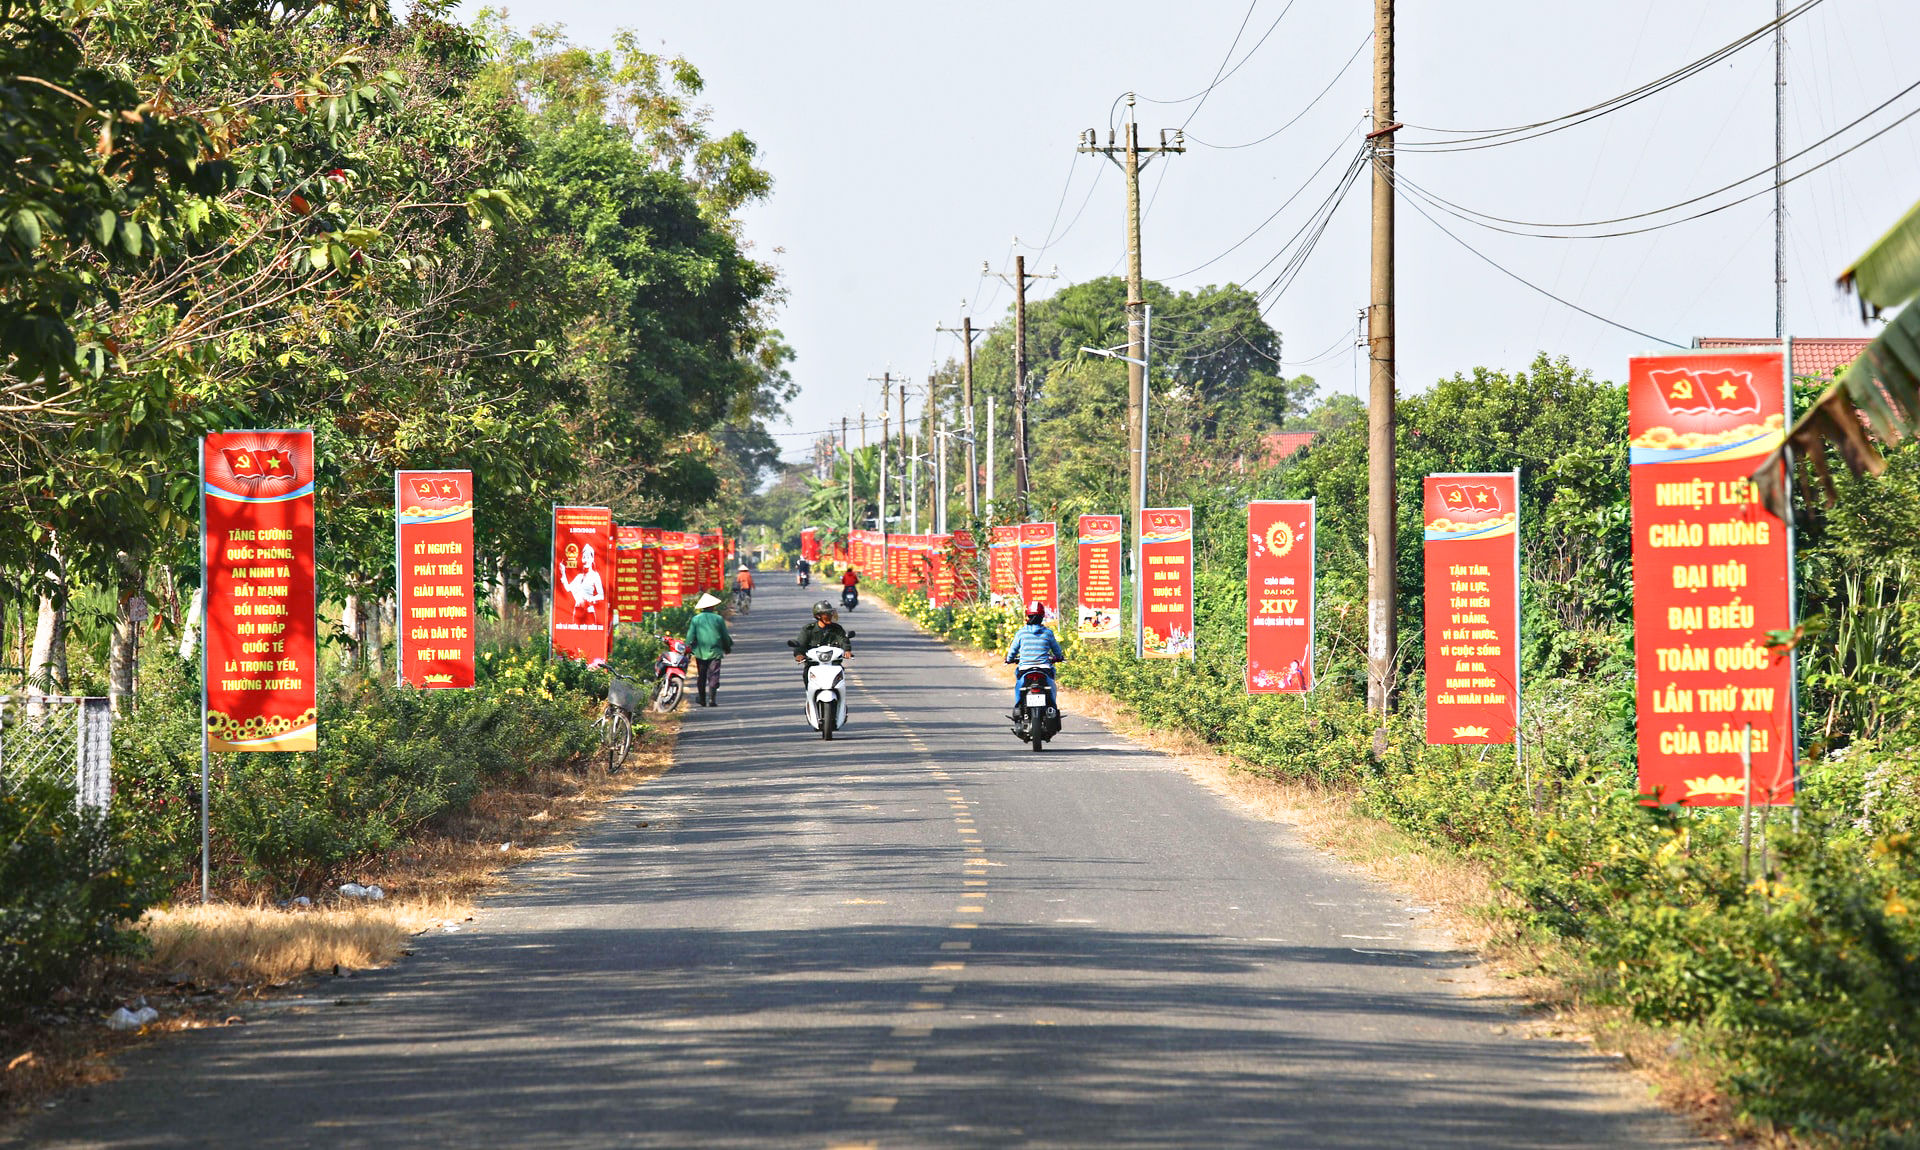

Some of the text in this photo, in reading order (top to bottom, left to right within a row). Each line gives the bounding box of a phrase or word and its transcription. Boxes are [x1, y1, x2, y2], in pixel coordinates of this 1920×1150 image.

[1656, 478, 1714, 510] NHIỆT
[229, 528, 292, 540] TĂNG CƯỜNG
[1649, 518, 1769, 548] CHÀO MỪNG
[227, 546, 294, 560] QUỐC PHÒNG,
[415, 540, 462, 554] KỶ NGUYÊN
[232, 565, 290, 578] AN NINH VÀ
[414, 560, 463, 575] PHÁT TRIỂN
[1450, 564, 1490, 577] TẬN TÂM,
[1672, 560, 1746, 592] ĐẠI HỘI
[234, 584, 288, 598] ĐẨY MẠNH
[414, 584, 464, 598] GIÀU MẠNH,
[1451, 580, 1489, 593] TẬN LỰC,
[234, 602, 288, 617] ĐỐI NGOẠI,
[1260, 599, 1298, 613] XIV
[1450, 596, 1490, 609] TẬN HIẾN
[411, 606, 466, 620] THỊNH VƯỢNG
[1452, 612, 1489, 624] VÌ ĐẢNG,
[1668, 597, 1754, 634] ĐẠI BIỂU
[238, 621, 285, 636] HỘI NHẬP
[412, 626, 467, 640] CỦA DÂN TỘC
[1443, 628, 1498, 640] VÌ ĐẤT NƯỚC,
[242, 639, 284, 654] QUỐC TẾ
[1441, 644, 1500, 658] VÌ CUỘC SỐNG
[418, 648, 460, 662] VIỆT NAM!
[1656, 639, 1768, 672] TOÀN QUỐC
[225, 657, 298, 673] LÀ TRỌNG YẾU,
[1456, 660, 1486, 672] ẤM NO,
[222, 677, 302, 690] THƯỜNG XUYÊN!
[1446, 677, 1496, 690] HẠNH PHÚC
[1438, 692, 1506, 704] CỦA NHÂN DÂN!
[1653, 682, 1774, 712] LẦN THỨ XIV
[1660, 723, 1768, 756] CỦA ĐẢNG!
